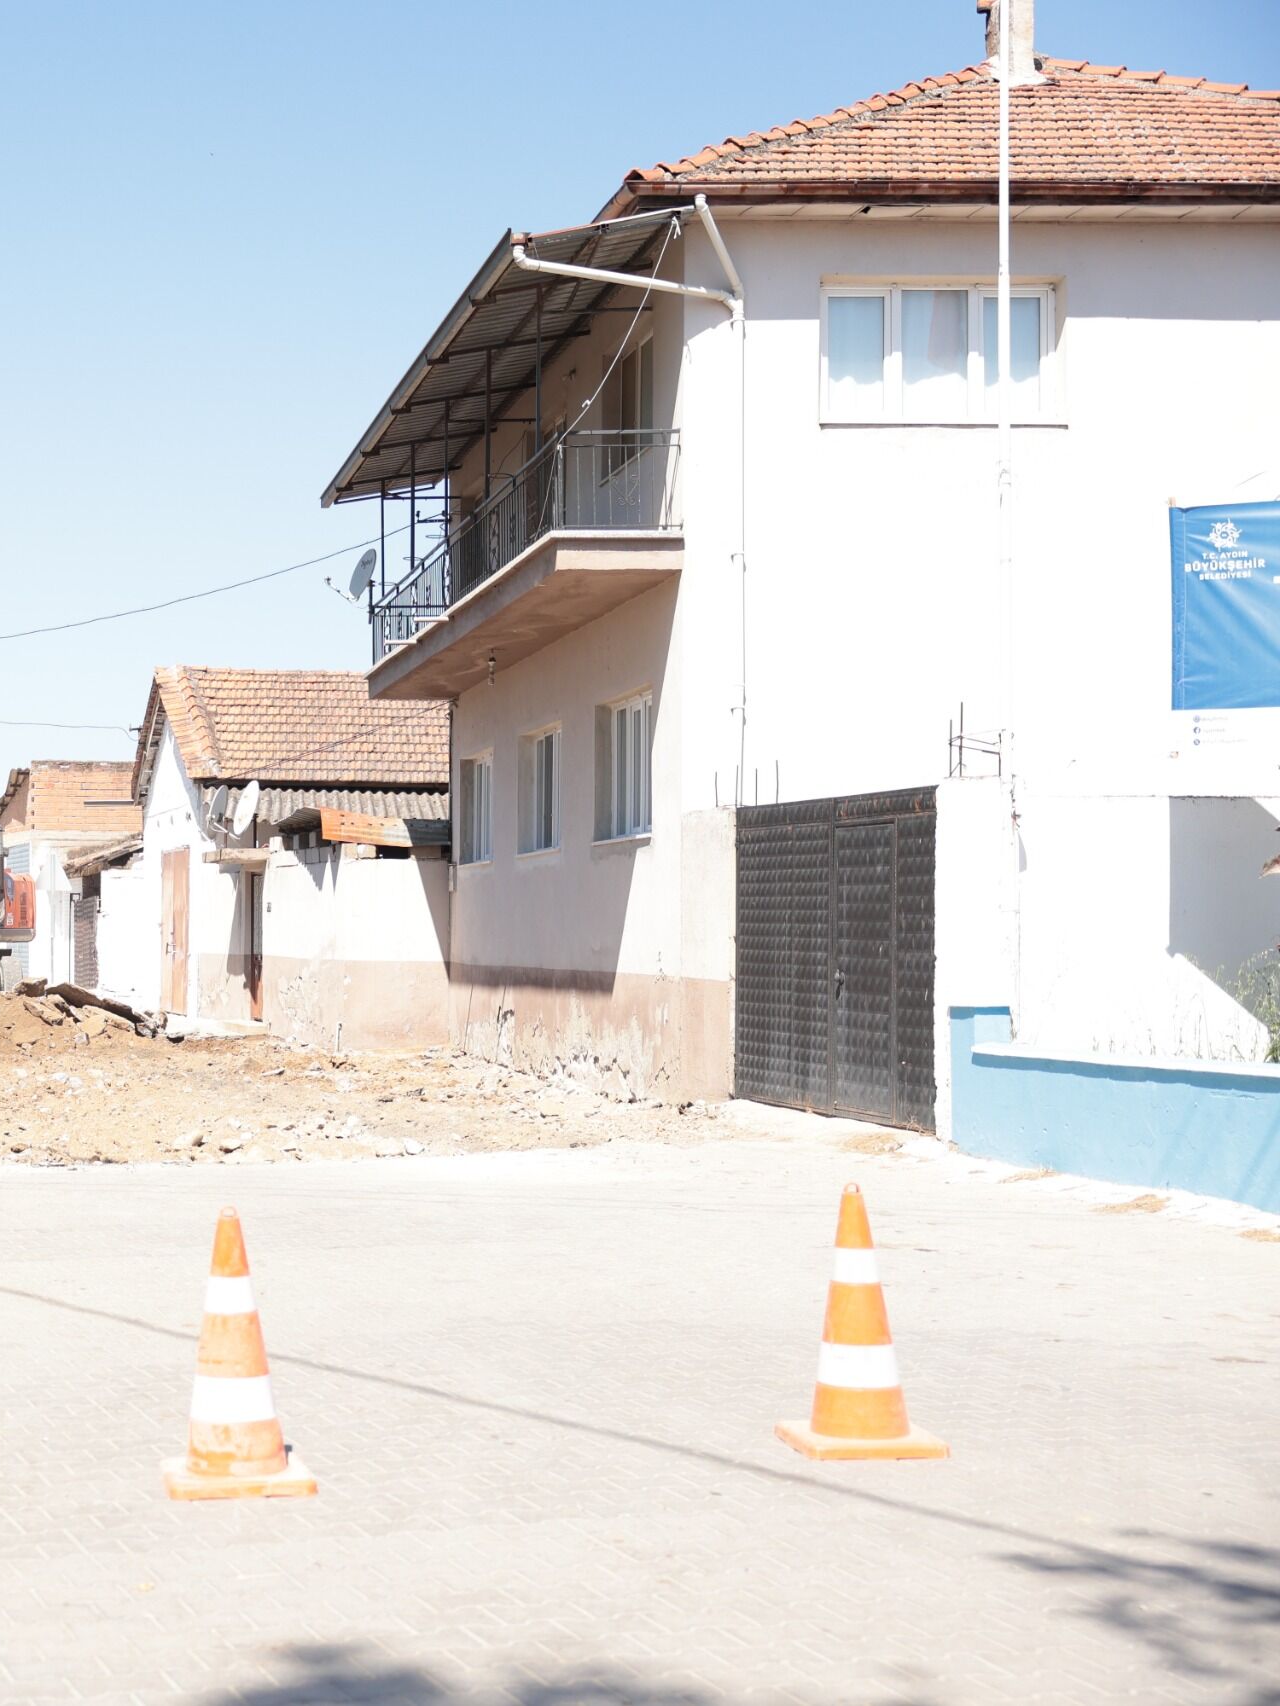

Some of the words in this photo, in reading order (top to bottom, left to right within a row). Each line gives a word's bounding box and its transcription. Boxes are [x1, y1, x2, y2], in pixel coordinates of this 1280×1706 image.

[1202, 552, 1218, 560] T.C.
[1220, 550, 1248, 559] AYDIN
[1184, 557, 1266, 572] BÜYÜKŞEHİR
[1199, 570, 1252, 580] BELEDİYESİ
